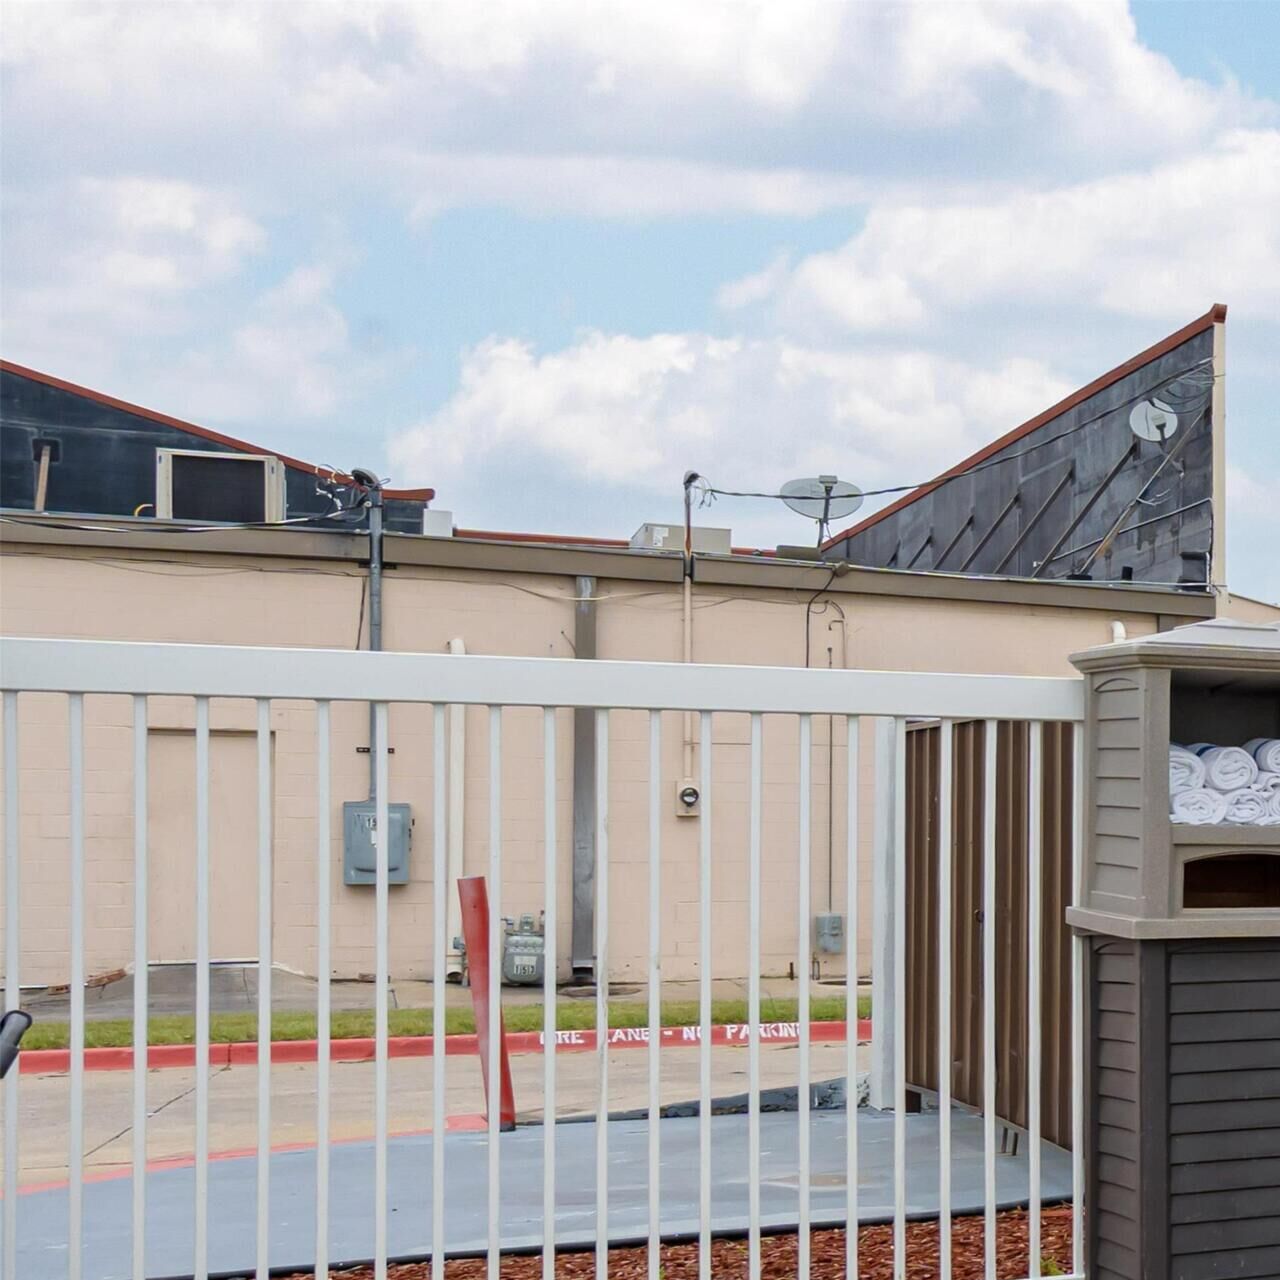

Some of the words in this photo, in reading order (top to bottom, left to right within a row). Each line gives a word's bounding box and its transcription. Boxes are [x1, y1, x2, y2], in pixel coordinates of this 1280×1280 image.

[540, 1029, 585, 1044] RE
[606, 1028, 650, 1043] ANE
[724, 1022, 801, 1040] PARKIN
